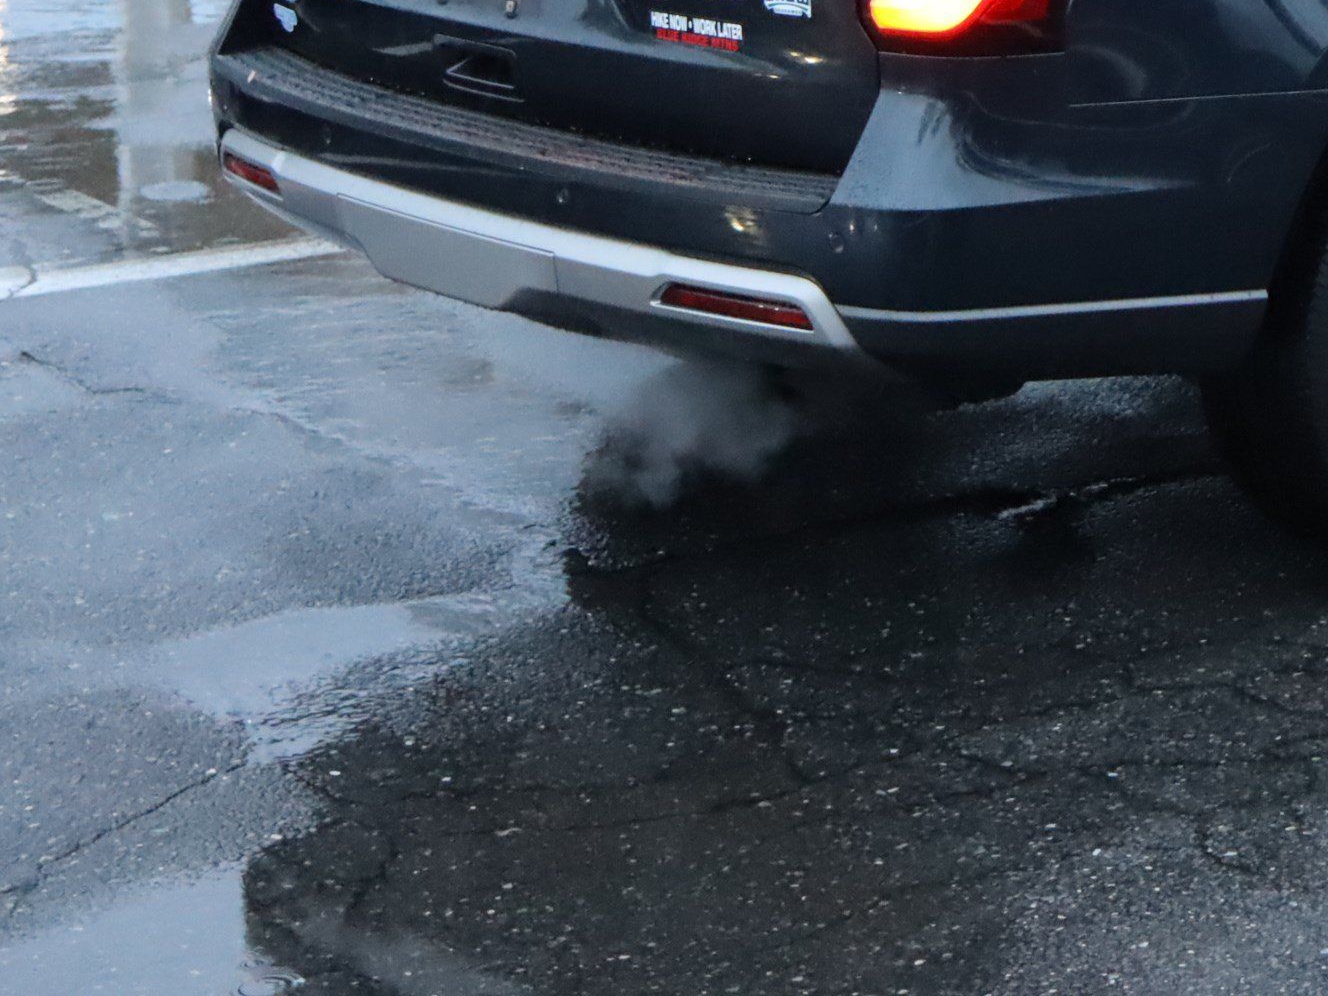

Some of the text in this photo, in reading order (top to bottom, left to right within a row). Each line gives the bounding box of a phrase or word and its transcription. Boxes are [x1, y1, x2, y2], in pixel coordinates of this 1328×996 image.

[650, 10, 743, 41] HIKE NOW WORK LATER
